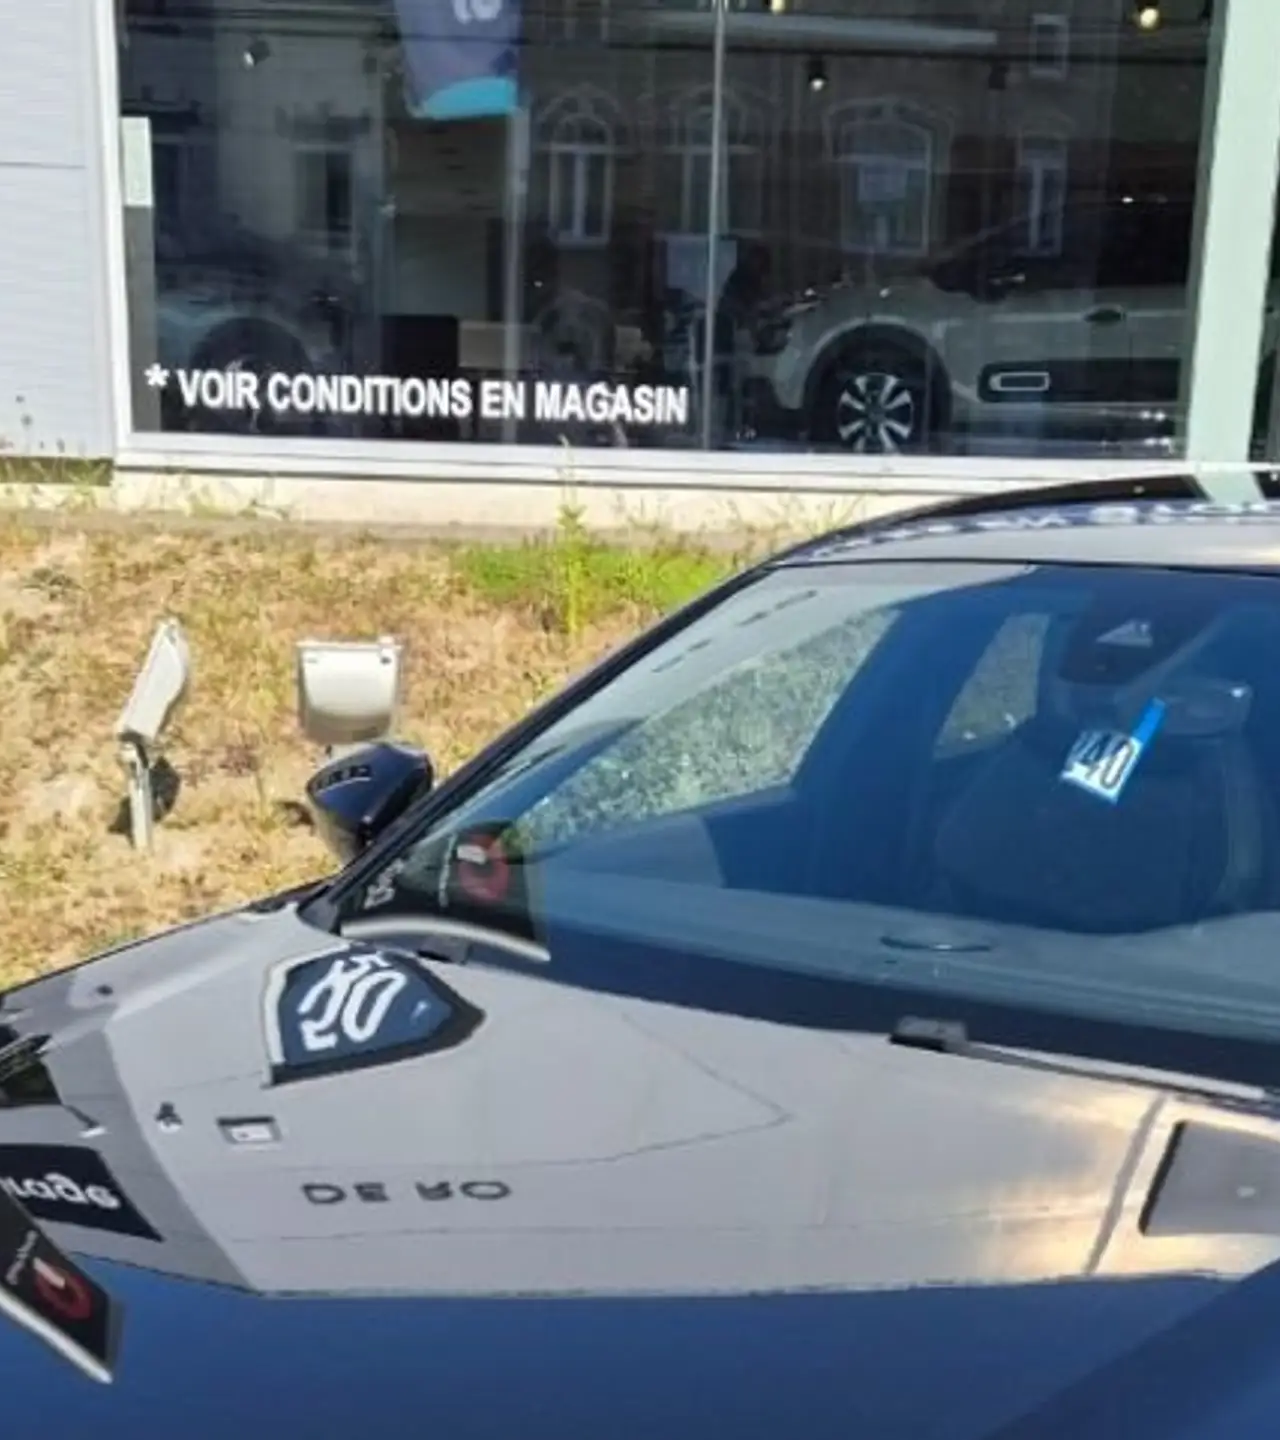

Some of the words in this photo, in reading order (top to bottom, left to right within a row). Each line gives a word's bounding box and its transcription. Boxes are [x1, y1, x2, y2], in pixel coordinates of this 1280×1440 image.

[177, 369, 260, 411] VOIR
[267, 373, 472, 419] CONDITIONS
[480, 381, 525, 421] EN
[534, 382, 689, 426] MAGASIN
